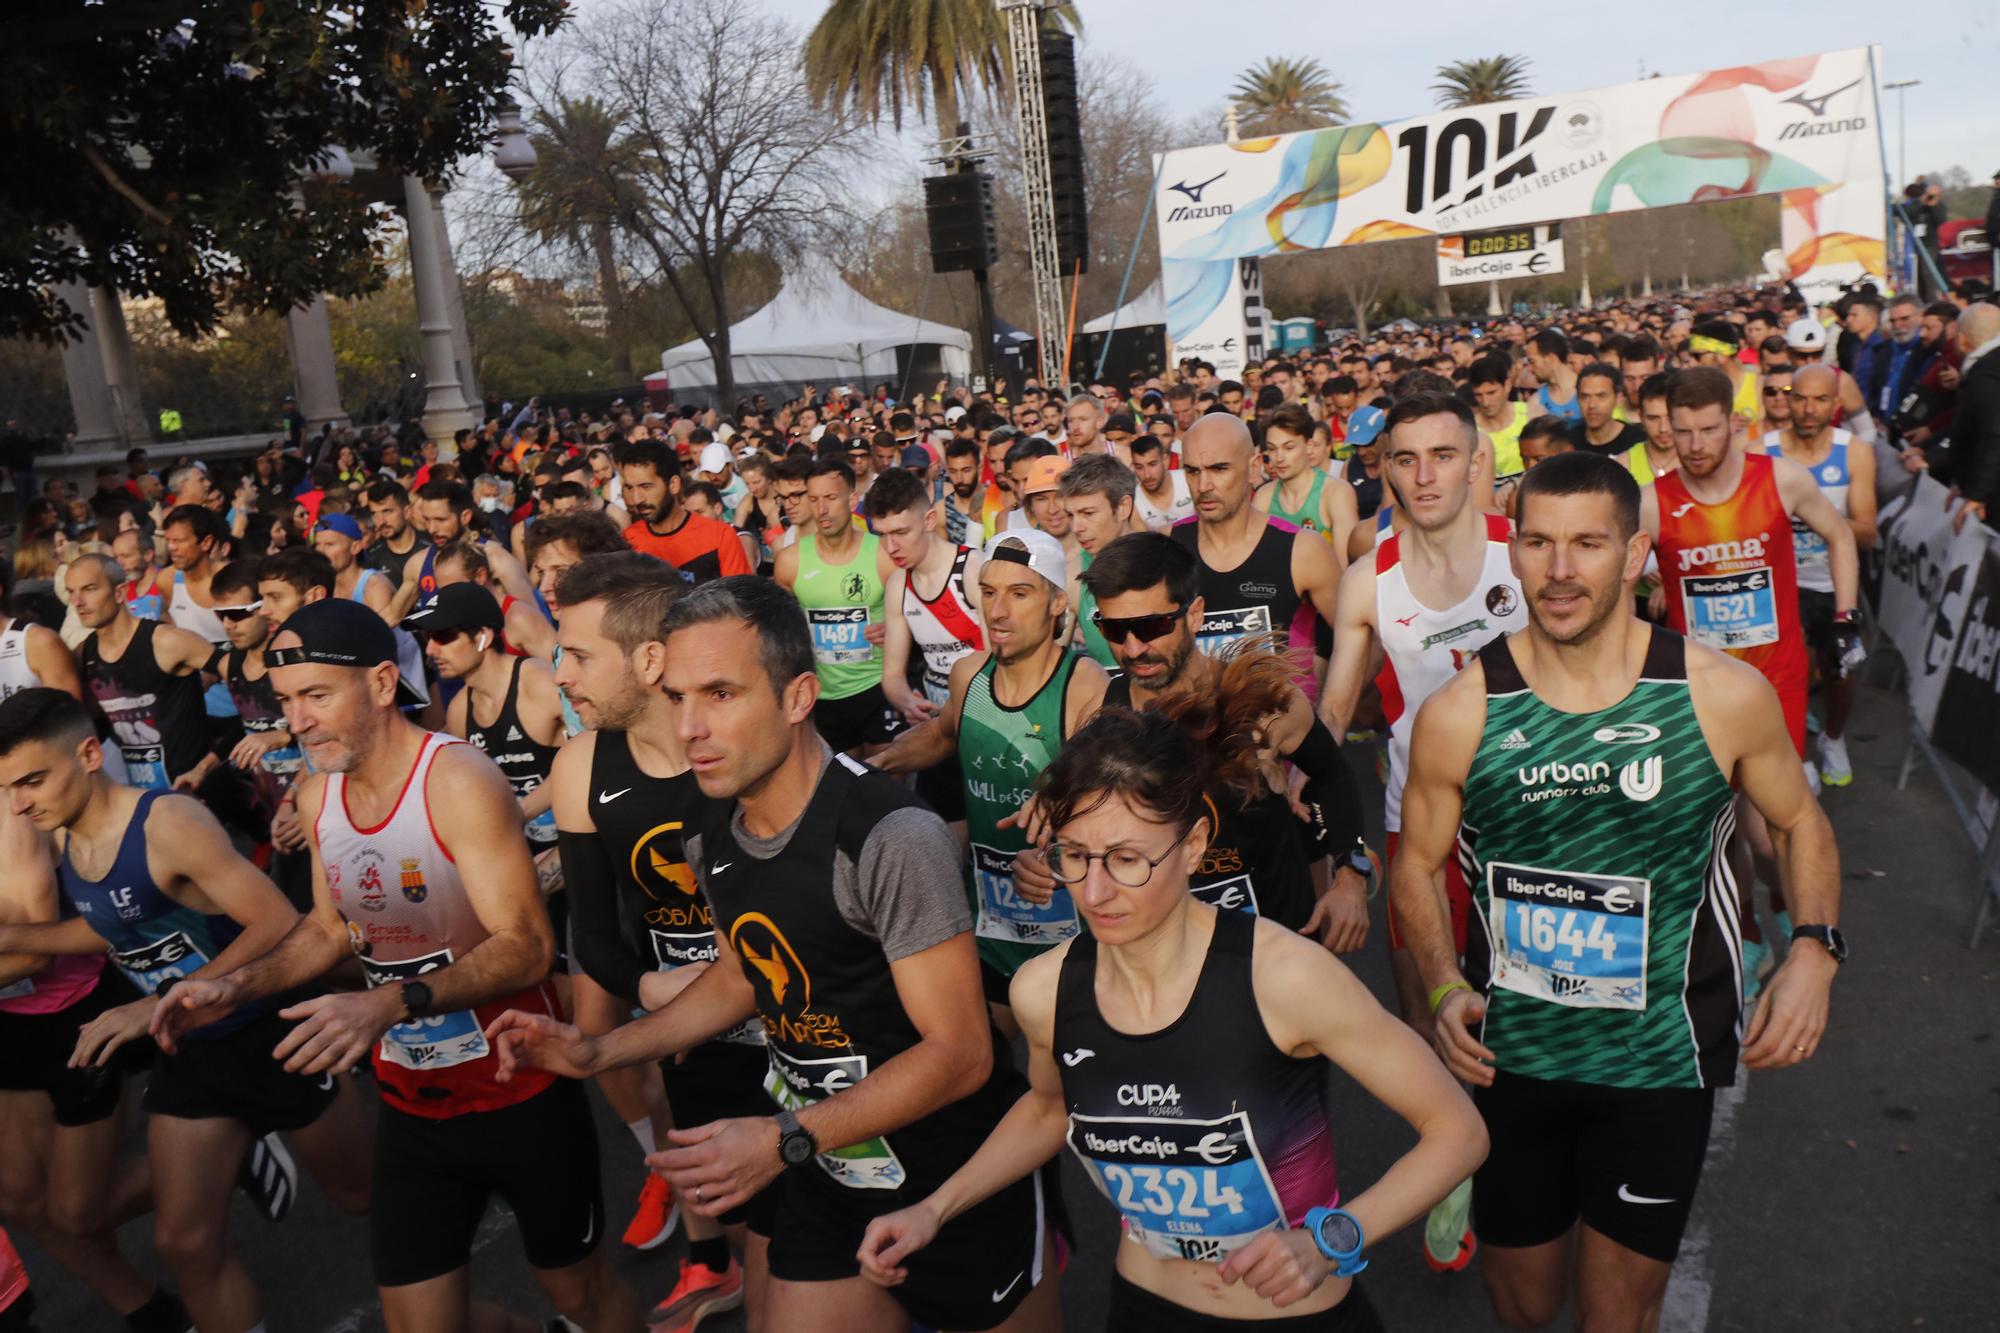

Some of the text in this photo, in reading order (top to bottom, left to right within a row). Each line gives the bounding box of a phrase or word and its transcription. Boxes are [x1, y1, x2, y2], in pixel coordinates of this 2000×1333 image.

[1777, 118, 1866, 141] MIZUNO
[1398, 106, 1556, 214] 10K
[1464, 184, 1531, 220] VALENCIA
[1536, 151, 1608, 190] IBERCAJA
[1166, 204, 1233, 222] MIZUNO
[1449, 260, 1513, 277] iberCaja
[1239, 582, 1277, 594] Gamo
[1693, 580, 1739, 592] iberCaja
[1704, 593, 1756, 622] 1521
[819, 624, 858, 643] 1487
[1519, 762, 1610, 786] urban
[968, 779, 996, 801] VALL
[1582, 783, 1610, 795] club
[109, 887, 132, 907] LF
[1507, 877, 1585, 903] iberCaja
[1517, 905, 1616, 961] 1644
[1552, 959, 1575, 972] JOSE
[1551, 974, 1588, 996] 10K
[1117, 1084, 1181, 1106] CUPA
[1085, 1132, 1178, 1159] iberCaja
[1104, 1164, 1244, 1217] 2324
[1166, 1220, 1204, 1233] ELENA
[1175, 1237, 1221, 1261] 10K
